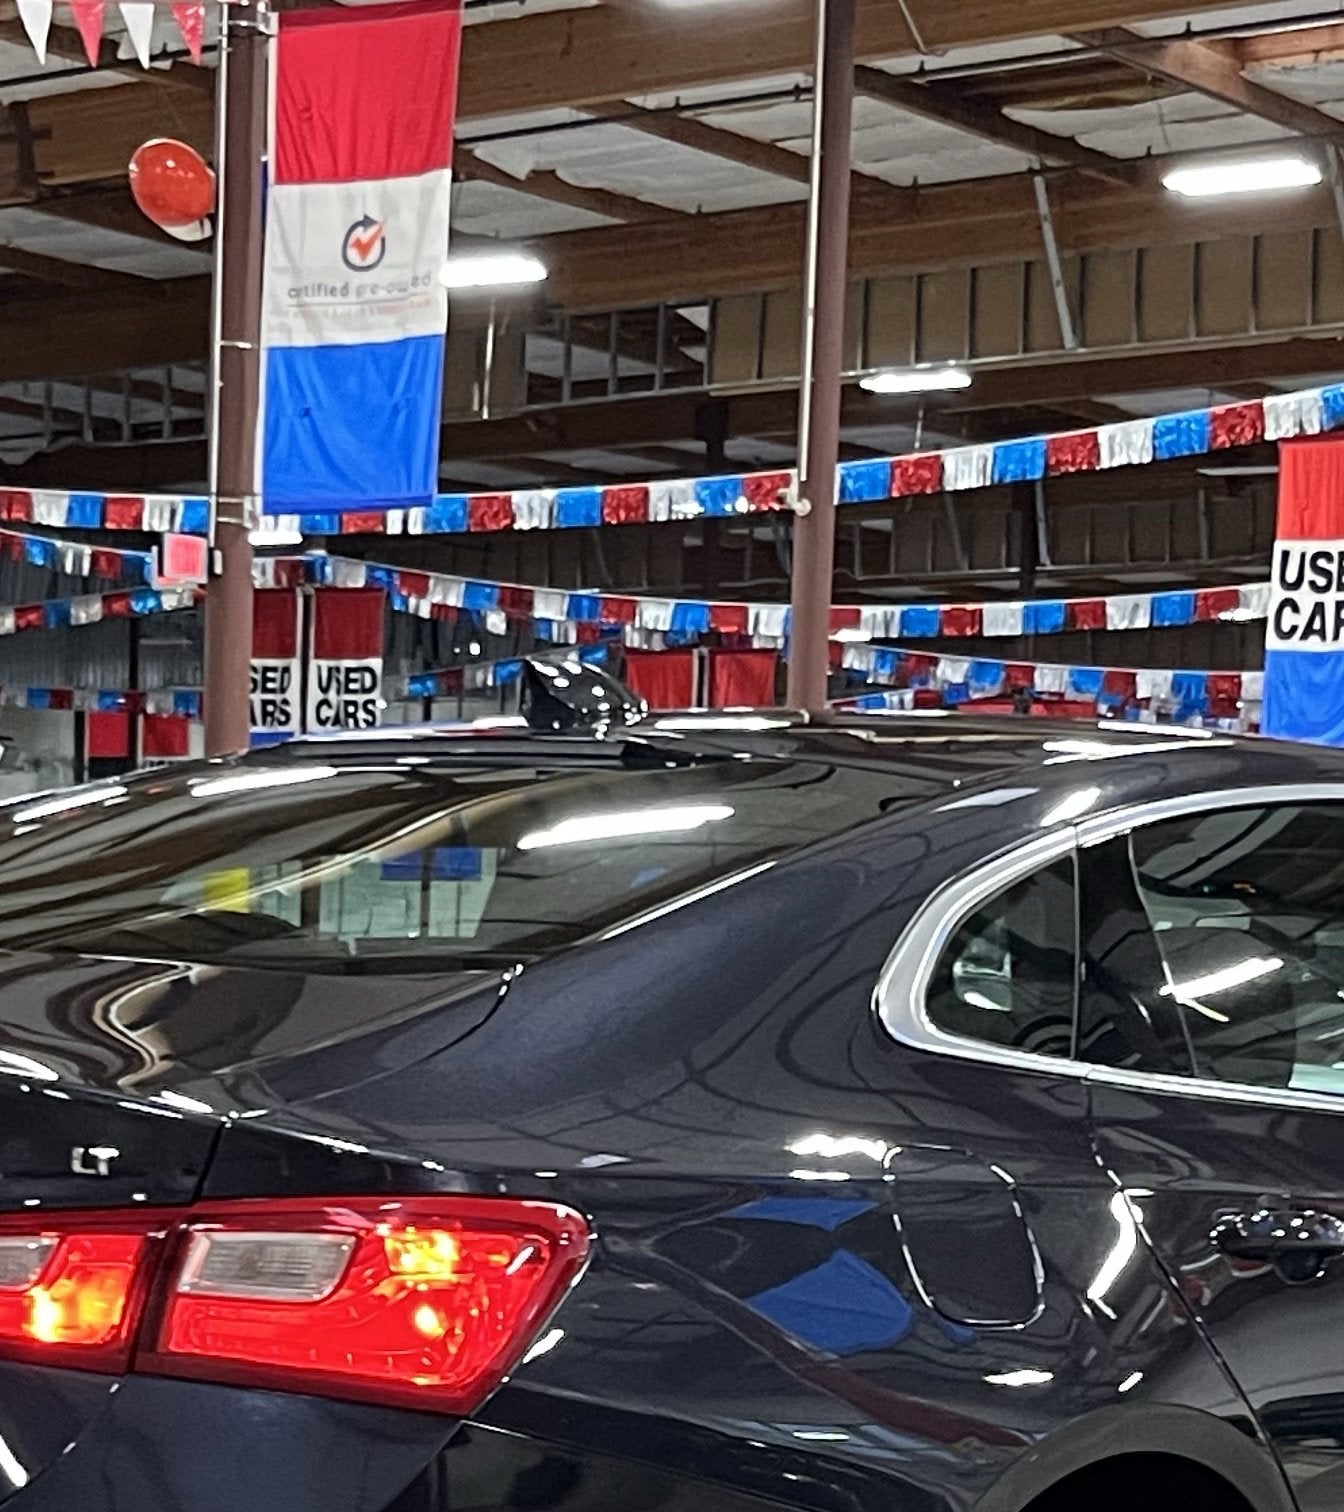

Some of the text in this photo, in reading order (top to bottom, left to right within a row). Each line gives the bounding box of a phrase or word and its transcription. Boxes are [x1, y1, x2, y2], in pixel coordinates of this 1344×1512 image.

[249, 664, 292, 694] SED
[317, 664, 377, 695] USED
[316, 698, 376, 728] CARS
[71, 1147, 119, 1175] LT
